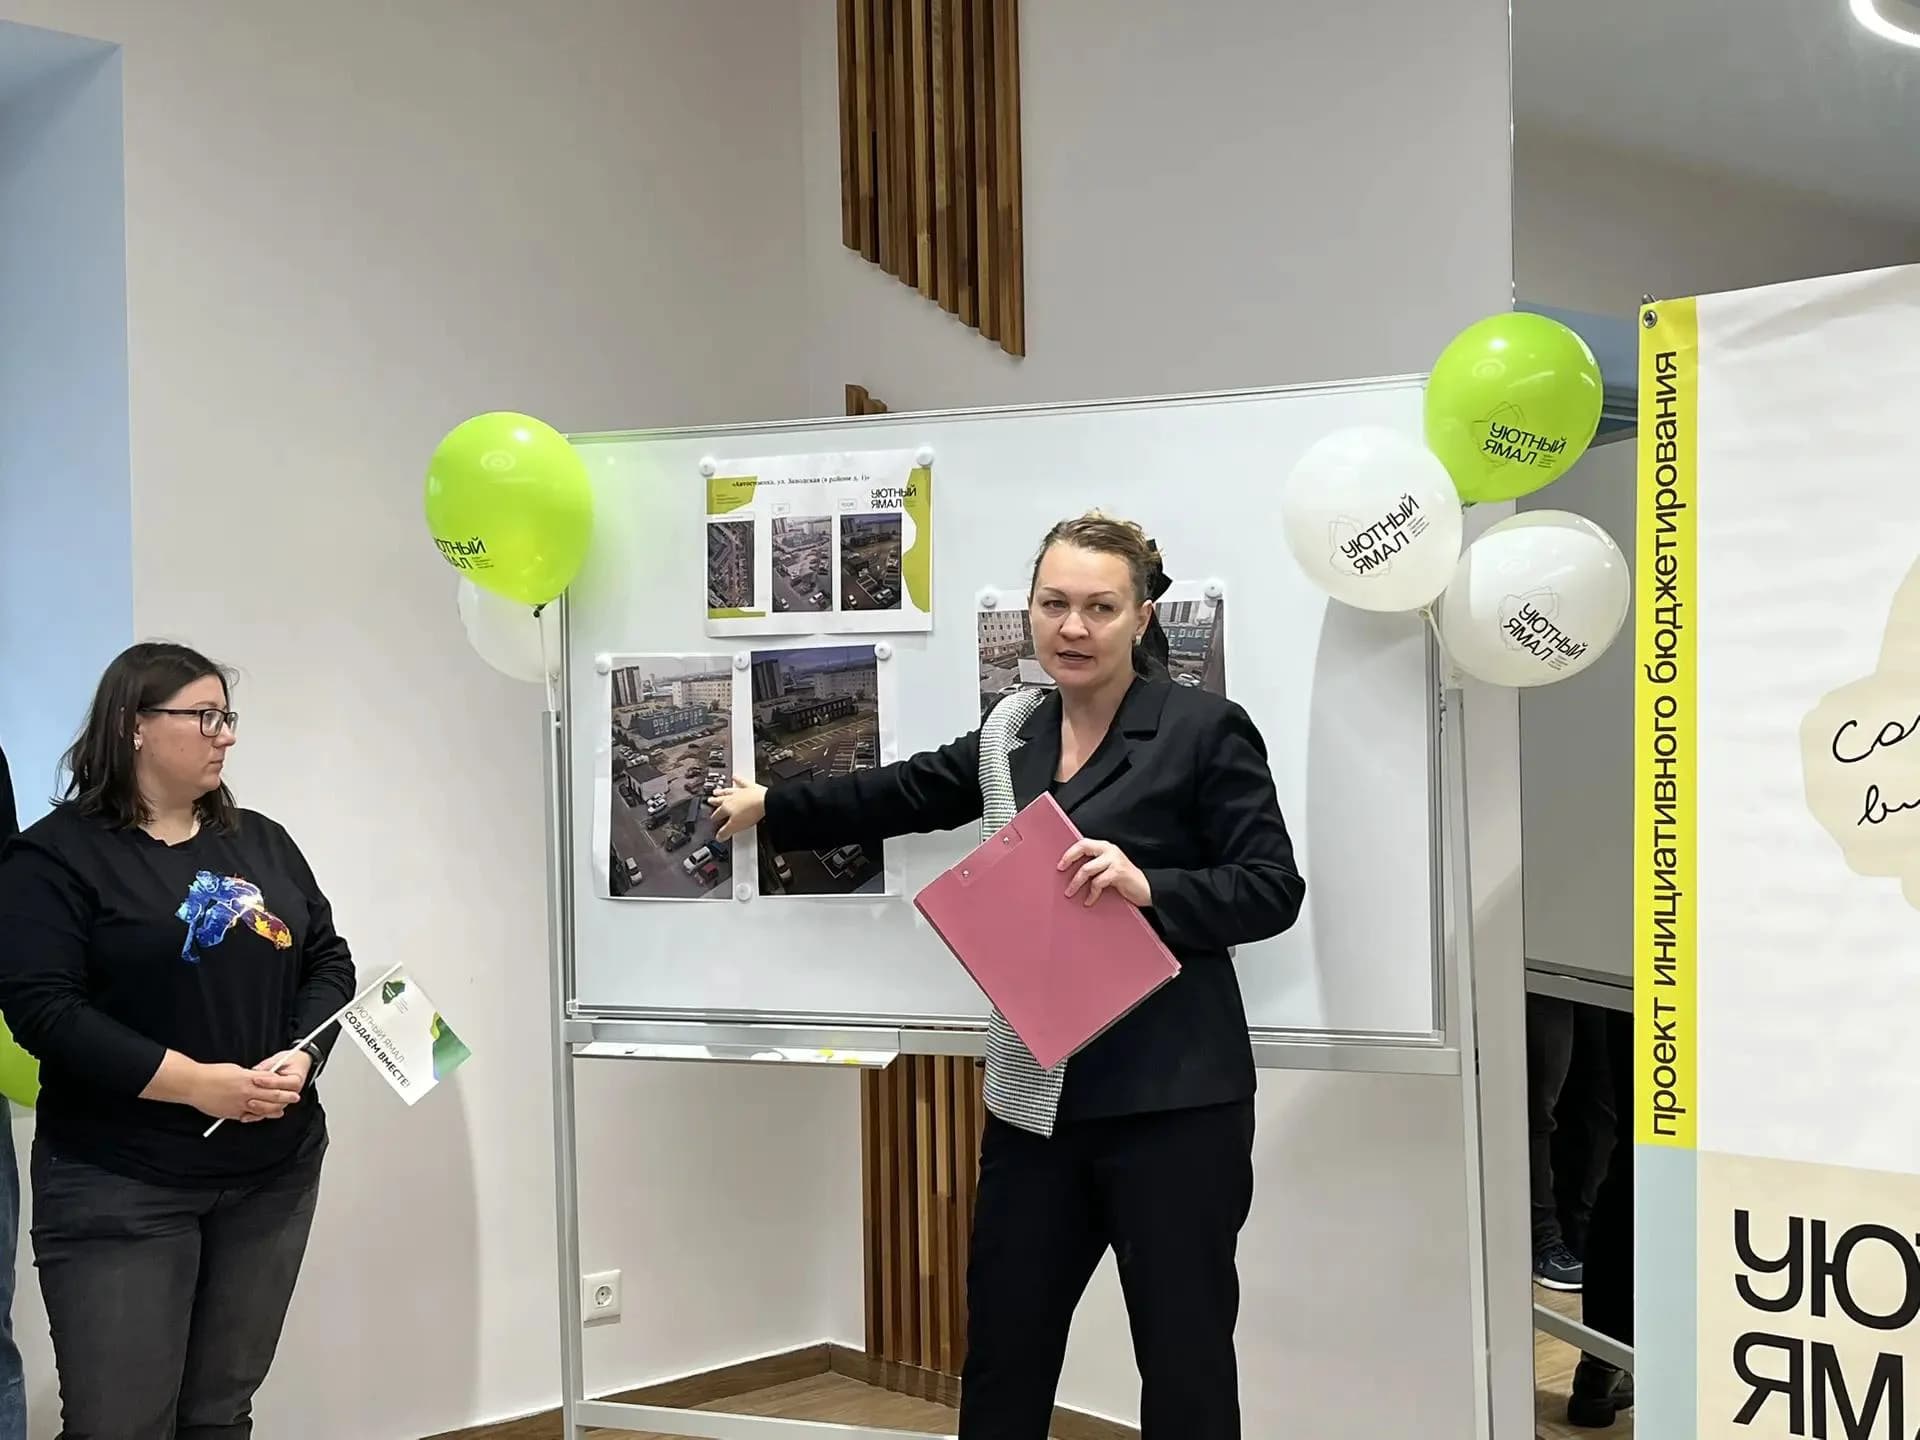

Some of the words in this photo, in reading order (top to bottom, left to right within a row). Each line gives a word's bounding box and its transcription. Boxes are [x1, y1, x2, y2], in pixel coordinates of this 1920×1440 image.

[1483, 439, 1537, 464] ЯМАЛ
[1490, 422, 1567, 454] УЮТНЫЙ
[871, 484, 917, 498] УЮТНЫЙ
[871, 499, 902, 509] ЯМАЛ
[1340, 493, 1420, 559] УЮТНЫЙ
[1644, 351, 1687, 684] бюджетирования
[1353, 530, 1410, 574] ЯМАЛ
[1503, 617, 1554, 661] ЯМАЛ
[1519, 603, 1588, 660] УЮТНЫЙ
[1653, 695, 1683, 986] инициативного
[377, 1051, 411, 1089] ВМЕСТЕ!
[1653, 997, 1686, 1136] проект
[1734, 1208, 1920, 1331] УЮ
[1733, 1331, 1920, 1440] ЯМ
